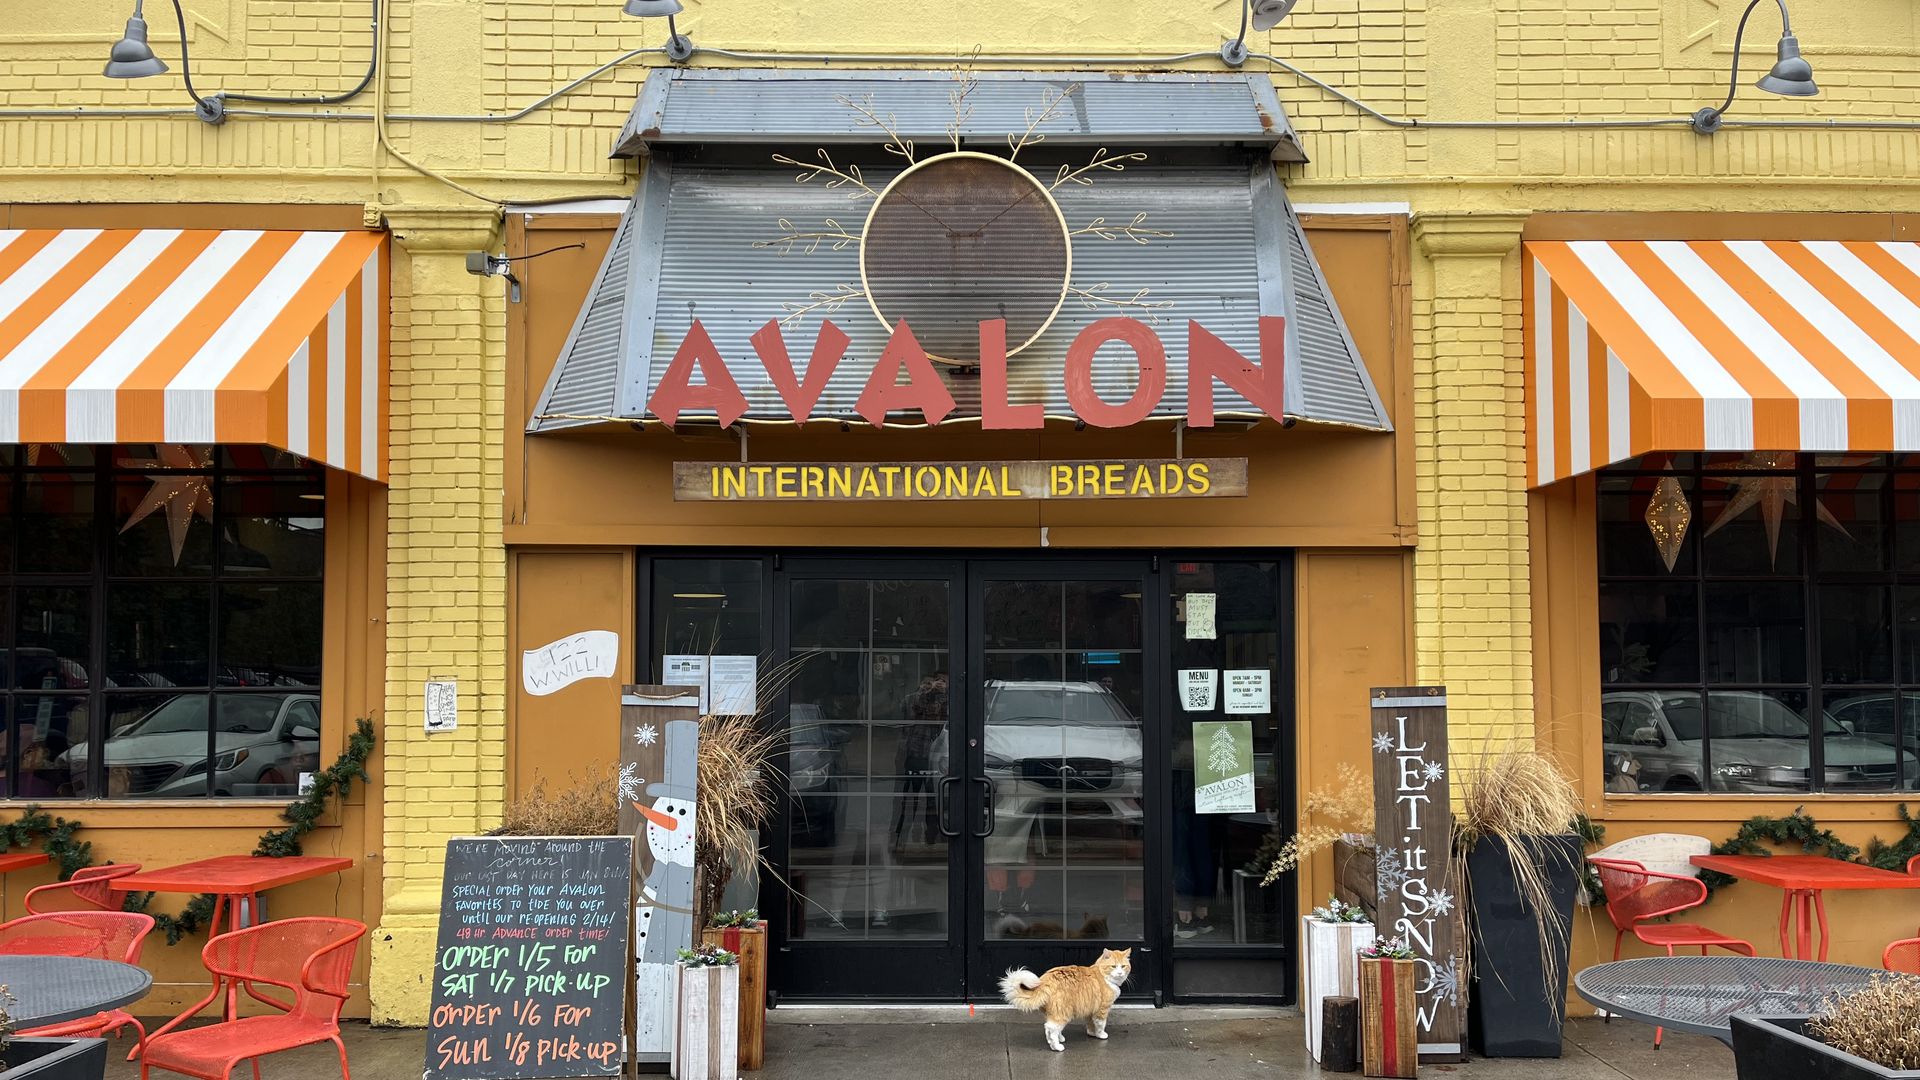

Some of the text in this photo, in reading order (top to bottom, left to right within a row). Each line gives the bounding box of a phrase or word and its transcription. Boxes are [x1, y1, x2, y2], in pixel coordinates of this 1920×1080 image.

[646, 316, 1286, 430] AVALON
[710, 462, 1211, 499] INTERNATIONAL BREADS
[1189, 672, 1208, 680] MENU
[1204, 777, 1244, 796] AVALON
[1395, 716, 1430, 830] LET
[452, 885, 491, 898] SPECIAL
[510, 900, 521, 909] TO
[456, 928, 471, 940] 48
[582, 912, 616, 929] 2/14!
[518, 942, 556, 972] 1/5
[441, 972, 480, 997] SAT
[489, 969, 516, 994] 1/7
[513, 999, 542, 1026] 1/6
[504, 1032, 531, 1066] 1/8
